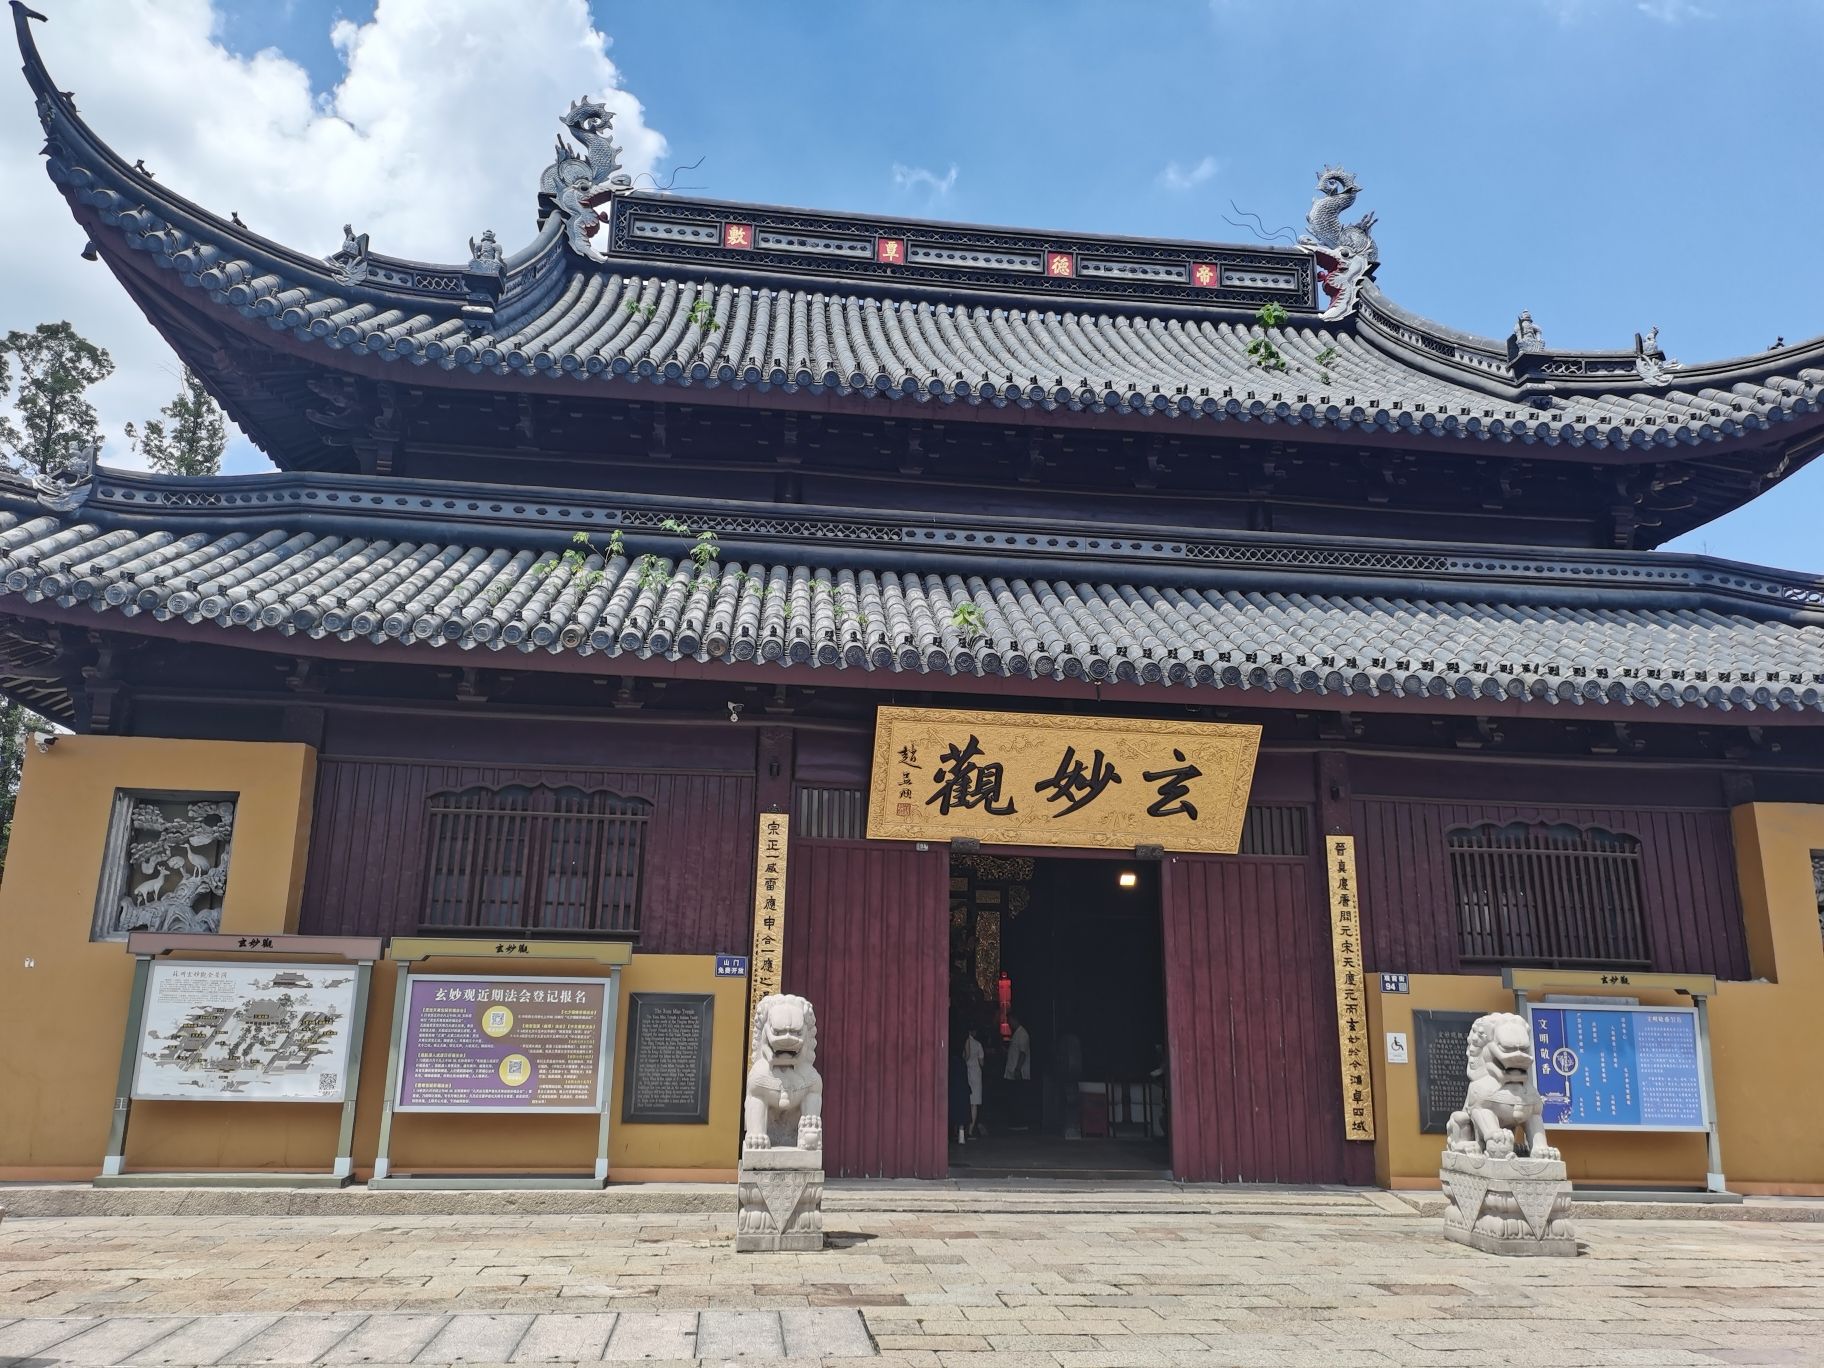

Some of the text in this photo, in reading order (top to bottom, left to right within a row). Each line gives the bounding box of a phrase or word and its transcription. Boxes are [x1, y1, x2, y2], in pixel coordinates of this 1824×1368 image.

[883, 241, 899, 261] 覃
[1051, 255, 1070, 276] 德
[1196, 264, 1213, 285] 帝
[924, 733, 1203, 821] 玄妙觀
[237, 936, 274, 949] 玄妙觀
[495, 943, 530, 954] 玄妙觀
[717, 967, 744, 975] 免费开放
[723, 959, 740, 967] 山门
[1600, 974, 1630, 985] 玄妙觀
[434, 987, 587, 1004] 玄妙观近期法会登记报名
[1537, 1018, 1551, 1075] 文明敬香
